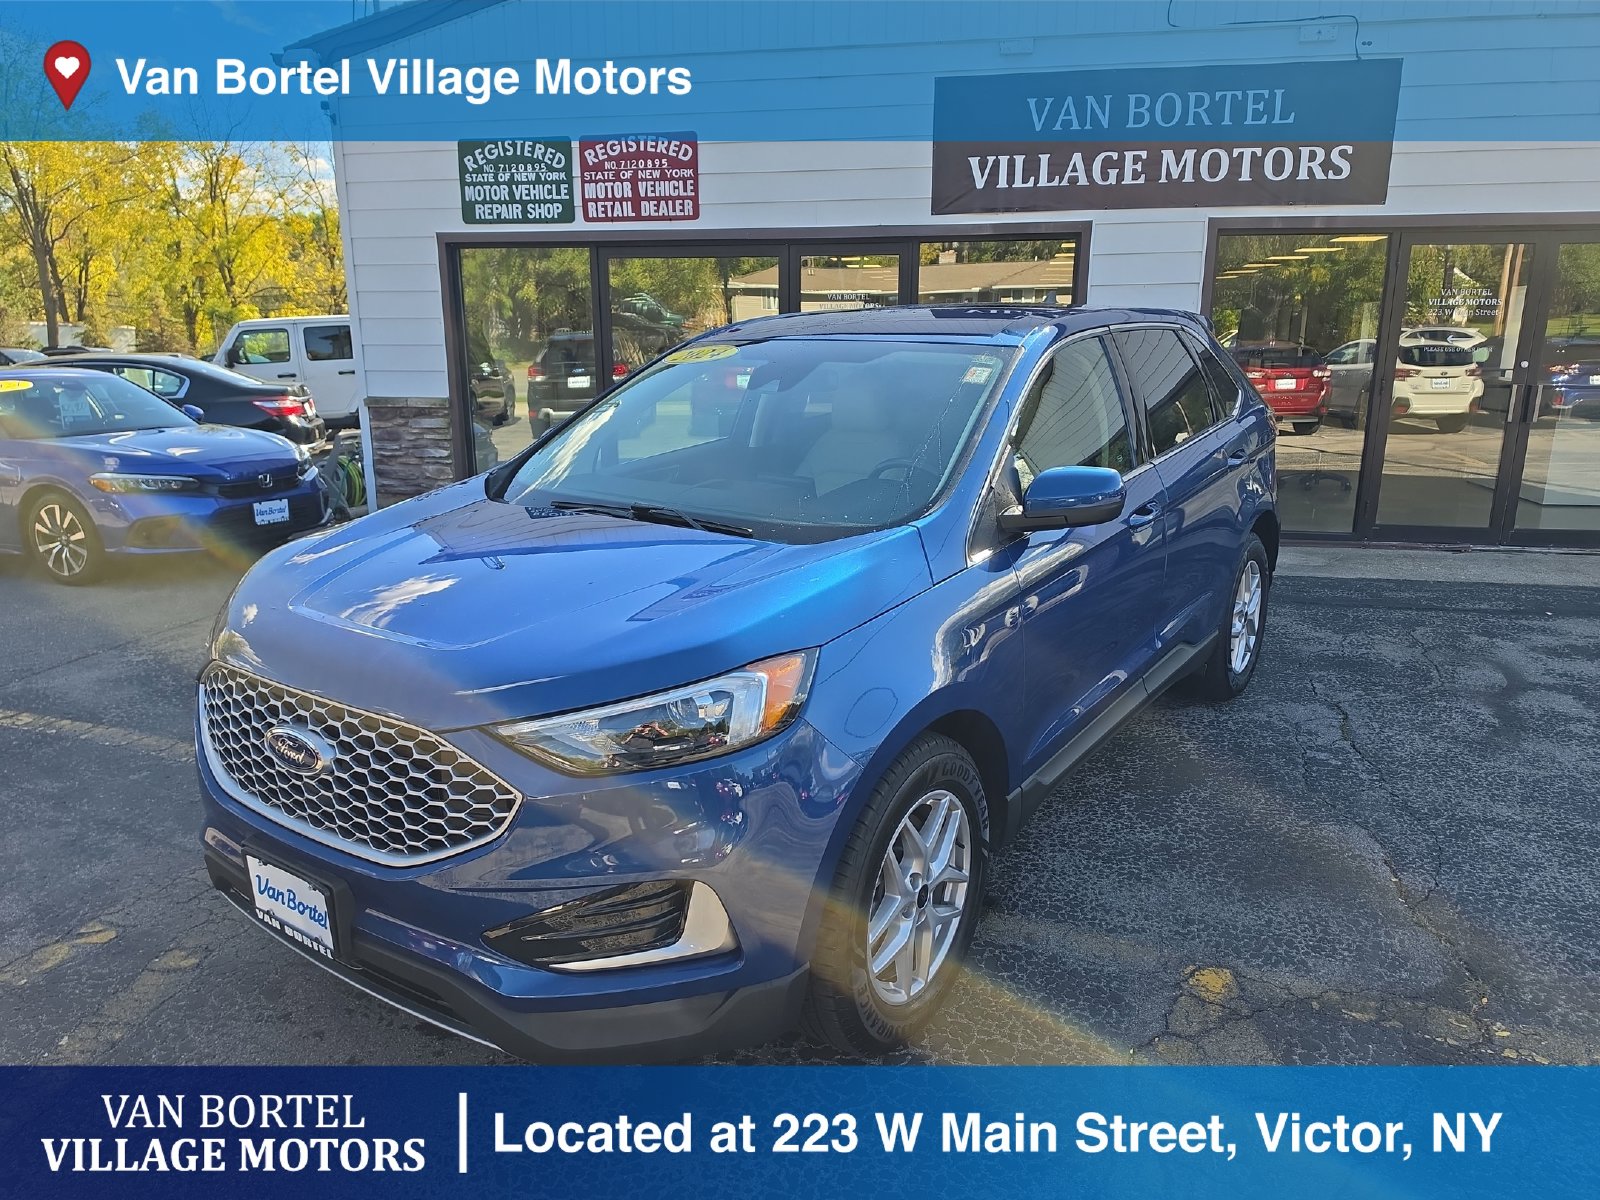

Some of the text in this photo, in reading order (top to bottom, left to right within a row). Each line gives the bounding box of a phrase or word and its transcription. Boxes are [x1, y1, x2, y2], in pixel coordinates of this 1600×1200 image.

[1027, 88, 1296, 132] VAN BORTEL
[463, 140, 566, 172] REGISTERED
[584, 135, 693, 166] REGISTERED
[483, 163, 547, 173] NO. 7120895
[604, 159, 668, 170] NO. 7120895
[967, 145, 1354, 190] VILLAGE MOTORS
[465, 172, 567, 182] STATE OF NEW YORK
[584, 169, 695, 180] STATE OF NEW YORK
[464, 184, 570, 201] MOTOR VEHICLE
[584, 180, 695, 199] MOTOR VEHICLE
[475, 203, 563, 219] REPAIR SHOP
[588, 200, 694, 218] RETAIL DEALER
[1460, 288, 1493, 296] BORTEL
[1428, 298, 1503, 306] VILLAGE MOTORS
[1475, 308, 1499, 316] Street
[276, 738, 307, 765] Ford
[942, 761, 989, 833] GOODYEAR
[255, 874, 328, 930] Van Bortel
